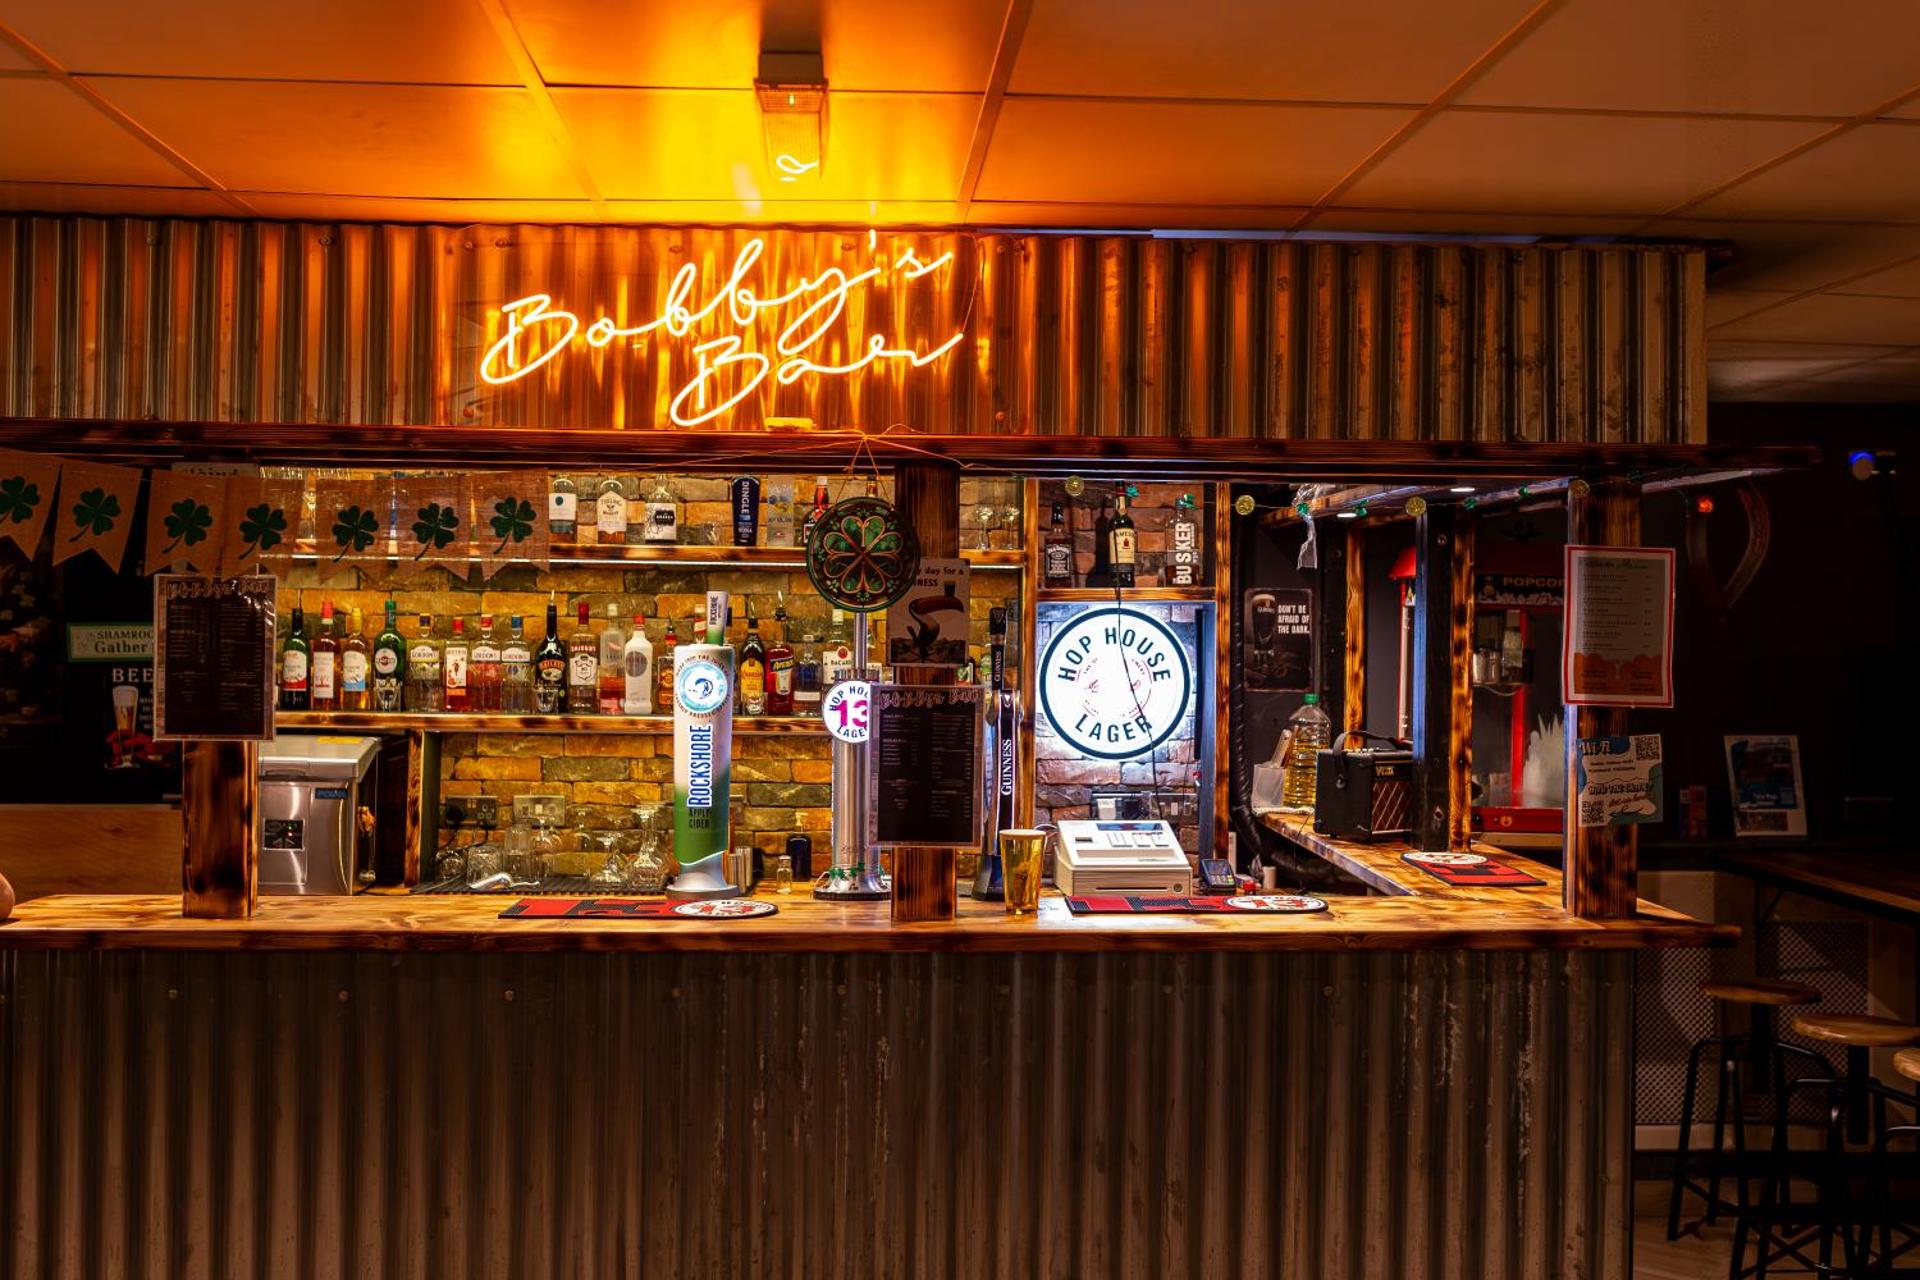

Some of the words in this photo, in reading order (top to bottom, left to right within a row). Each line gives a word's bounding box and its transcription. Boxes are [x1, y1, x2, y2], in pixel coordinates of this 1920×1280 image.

[480, 229, 953, 384] Bobby's
[670, 334, 963, 426] Bar
[741, 481, 750, 514] DINGLE
[1175, 522, 1192, 585] BUSKER
[1277, 604, 1296, 614] DON'T
[1298, 604, 1306, 614] BE
[1277, 614, 1300, 624] AFRAID
[1301, 615, 1310, 624] OF
[96, 631, 154, 641] SHAMROC
[1278, 625, 1290, 634] THE
[95, 642, 148, 655] Gather
[1057, 635, 1092, 682] HOP
[1105, 627, 1171, 682] HOUSE
[112, 668, 154, 683] BEE
[829, 689, 844, 711] HOP
[837, 700, 868, 727] 13
[836, 724, 868, 738] LAGE
[1074, 713, 1153, 742] LAGER
[688, 725, 711, 806] ROCKSHORE
[1000, 738, 1012, 796] GUINNESS
[688, 818, 709, 829] CIDER
